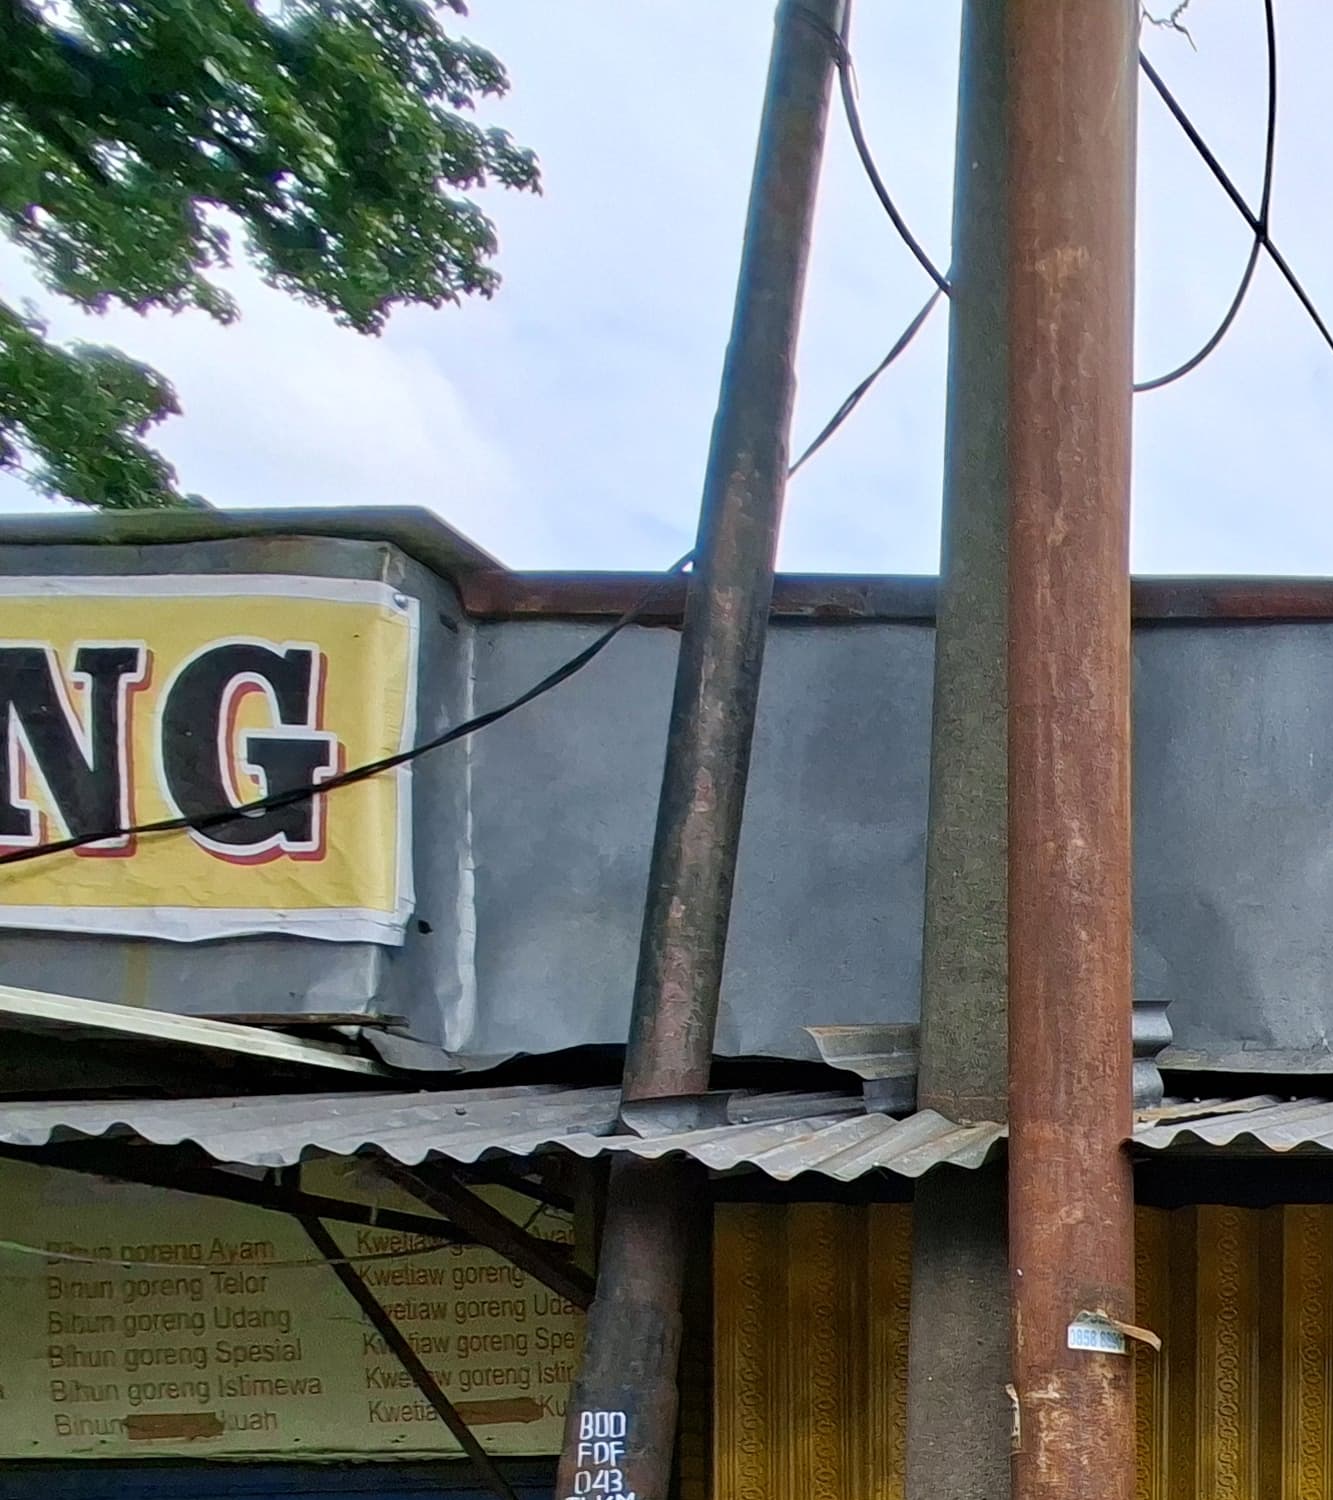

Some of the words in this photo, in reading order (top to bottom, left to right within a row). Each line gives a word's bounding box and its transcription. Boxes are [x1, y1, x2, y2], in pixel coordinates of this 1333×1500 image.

[123, 1276, 202, 1303] goreng
[210, 1271, 268, 1295] Telor
[452, 1264, 525, 1290] goreng
[123, 1311, 205, 1337] goreng
[214, 1306, 291, 1333] Udang
[454, 1298, 527, 1325] goreng
[49, 1345, 117, 1368] Bihun
[124, 1346, 208, 1372] goreng
[215, 1338, 302, 1367] Spesial
[456, 1333, 529, 1359] goreng
[51, 1380, 118, 1402] Bihun
[127, 1381, 210, 1406] goreng
[218, 1374, 323, 1398] Istimewa
[459, 1366, 531, 1392] goreng
